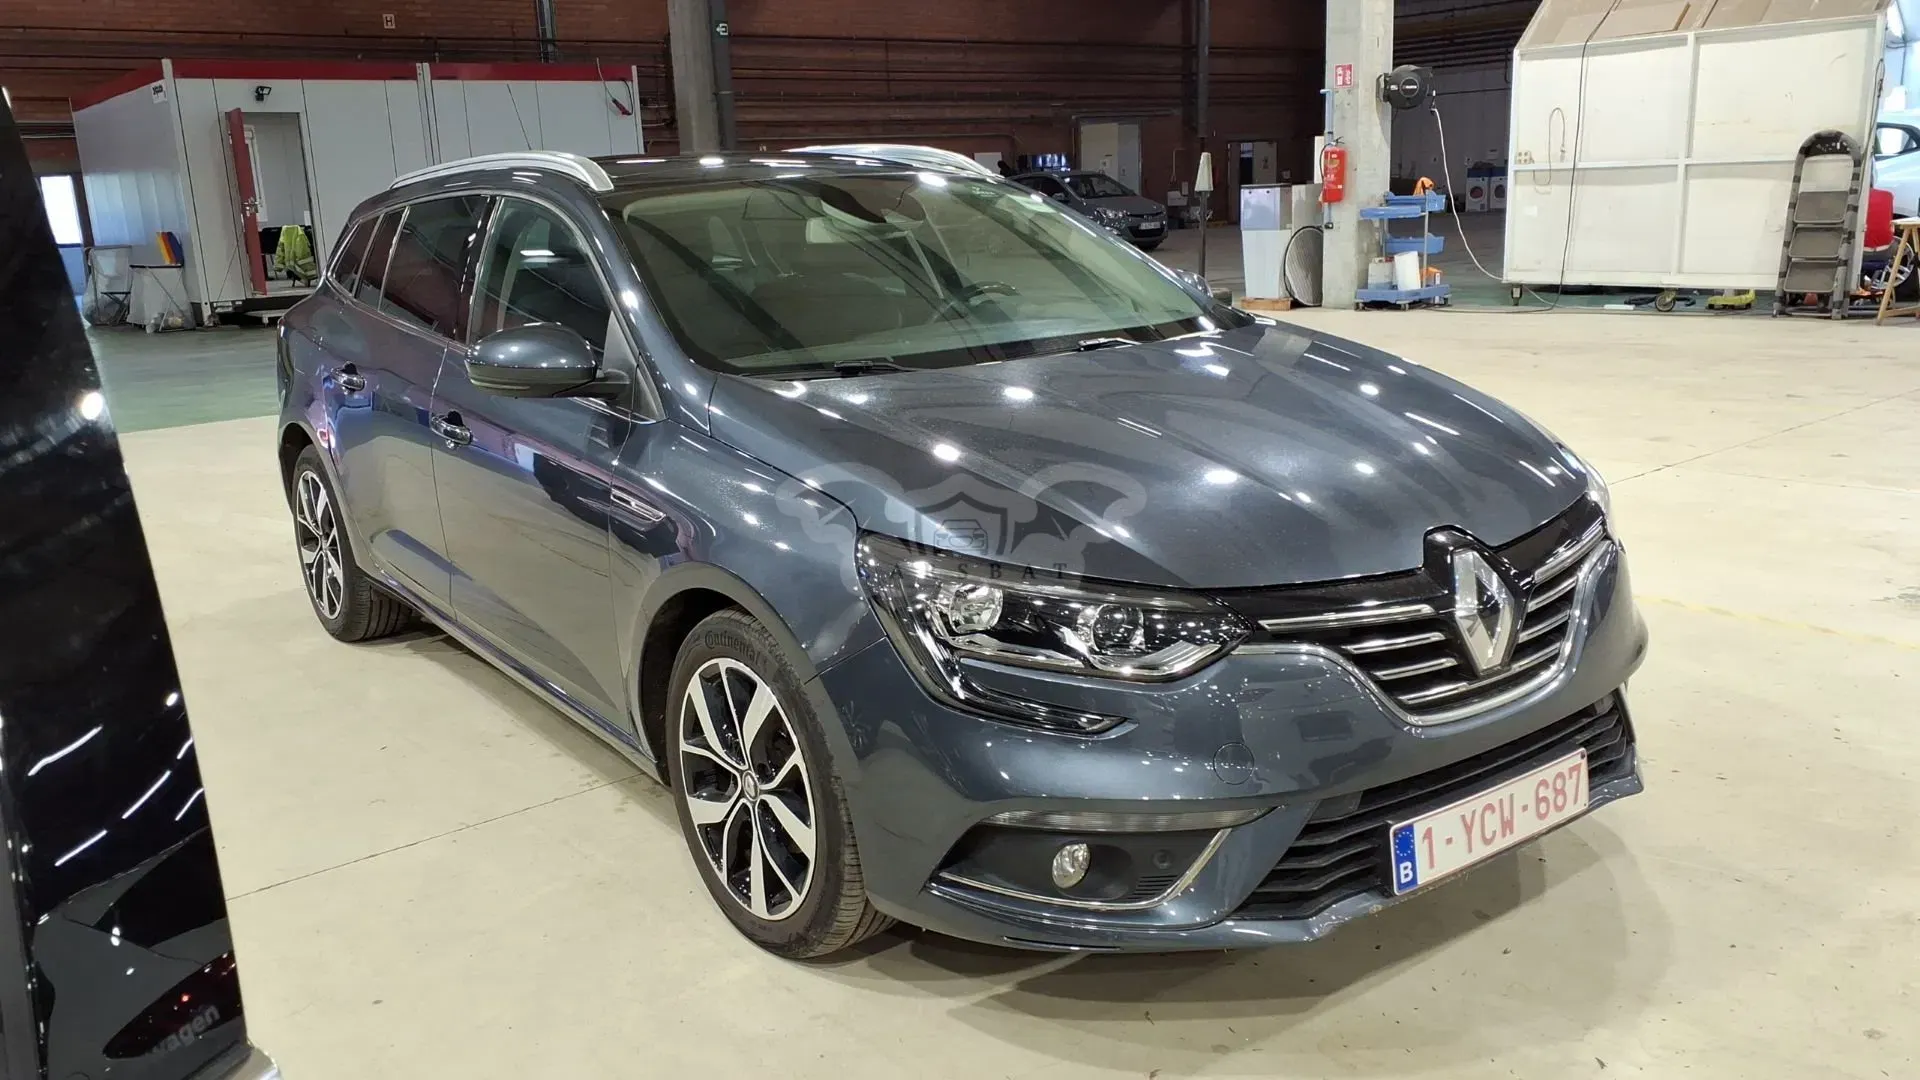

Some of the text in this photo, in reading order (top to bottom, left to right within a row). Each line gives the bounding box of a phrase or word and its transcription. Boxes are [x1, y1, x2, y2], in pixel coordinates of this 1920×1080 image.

[705, 630, 760, 662] Continental
[1422, 763, 1582, 869] 1-YCW-687
[1399, 861, 1413, 883] B
